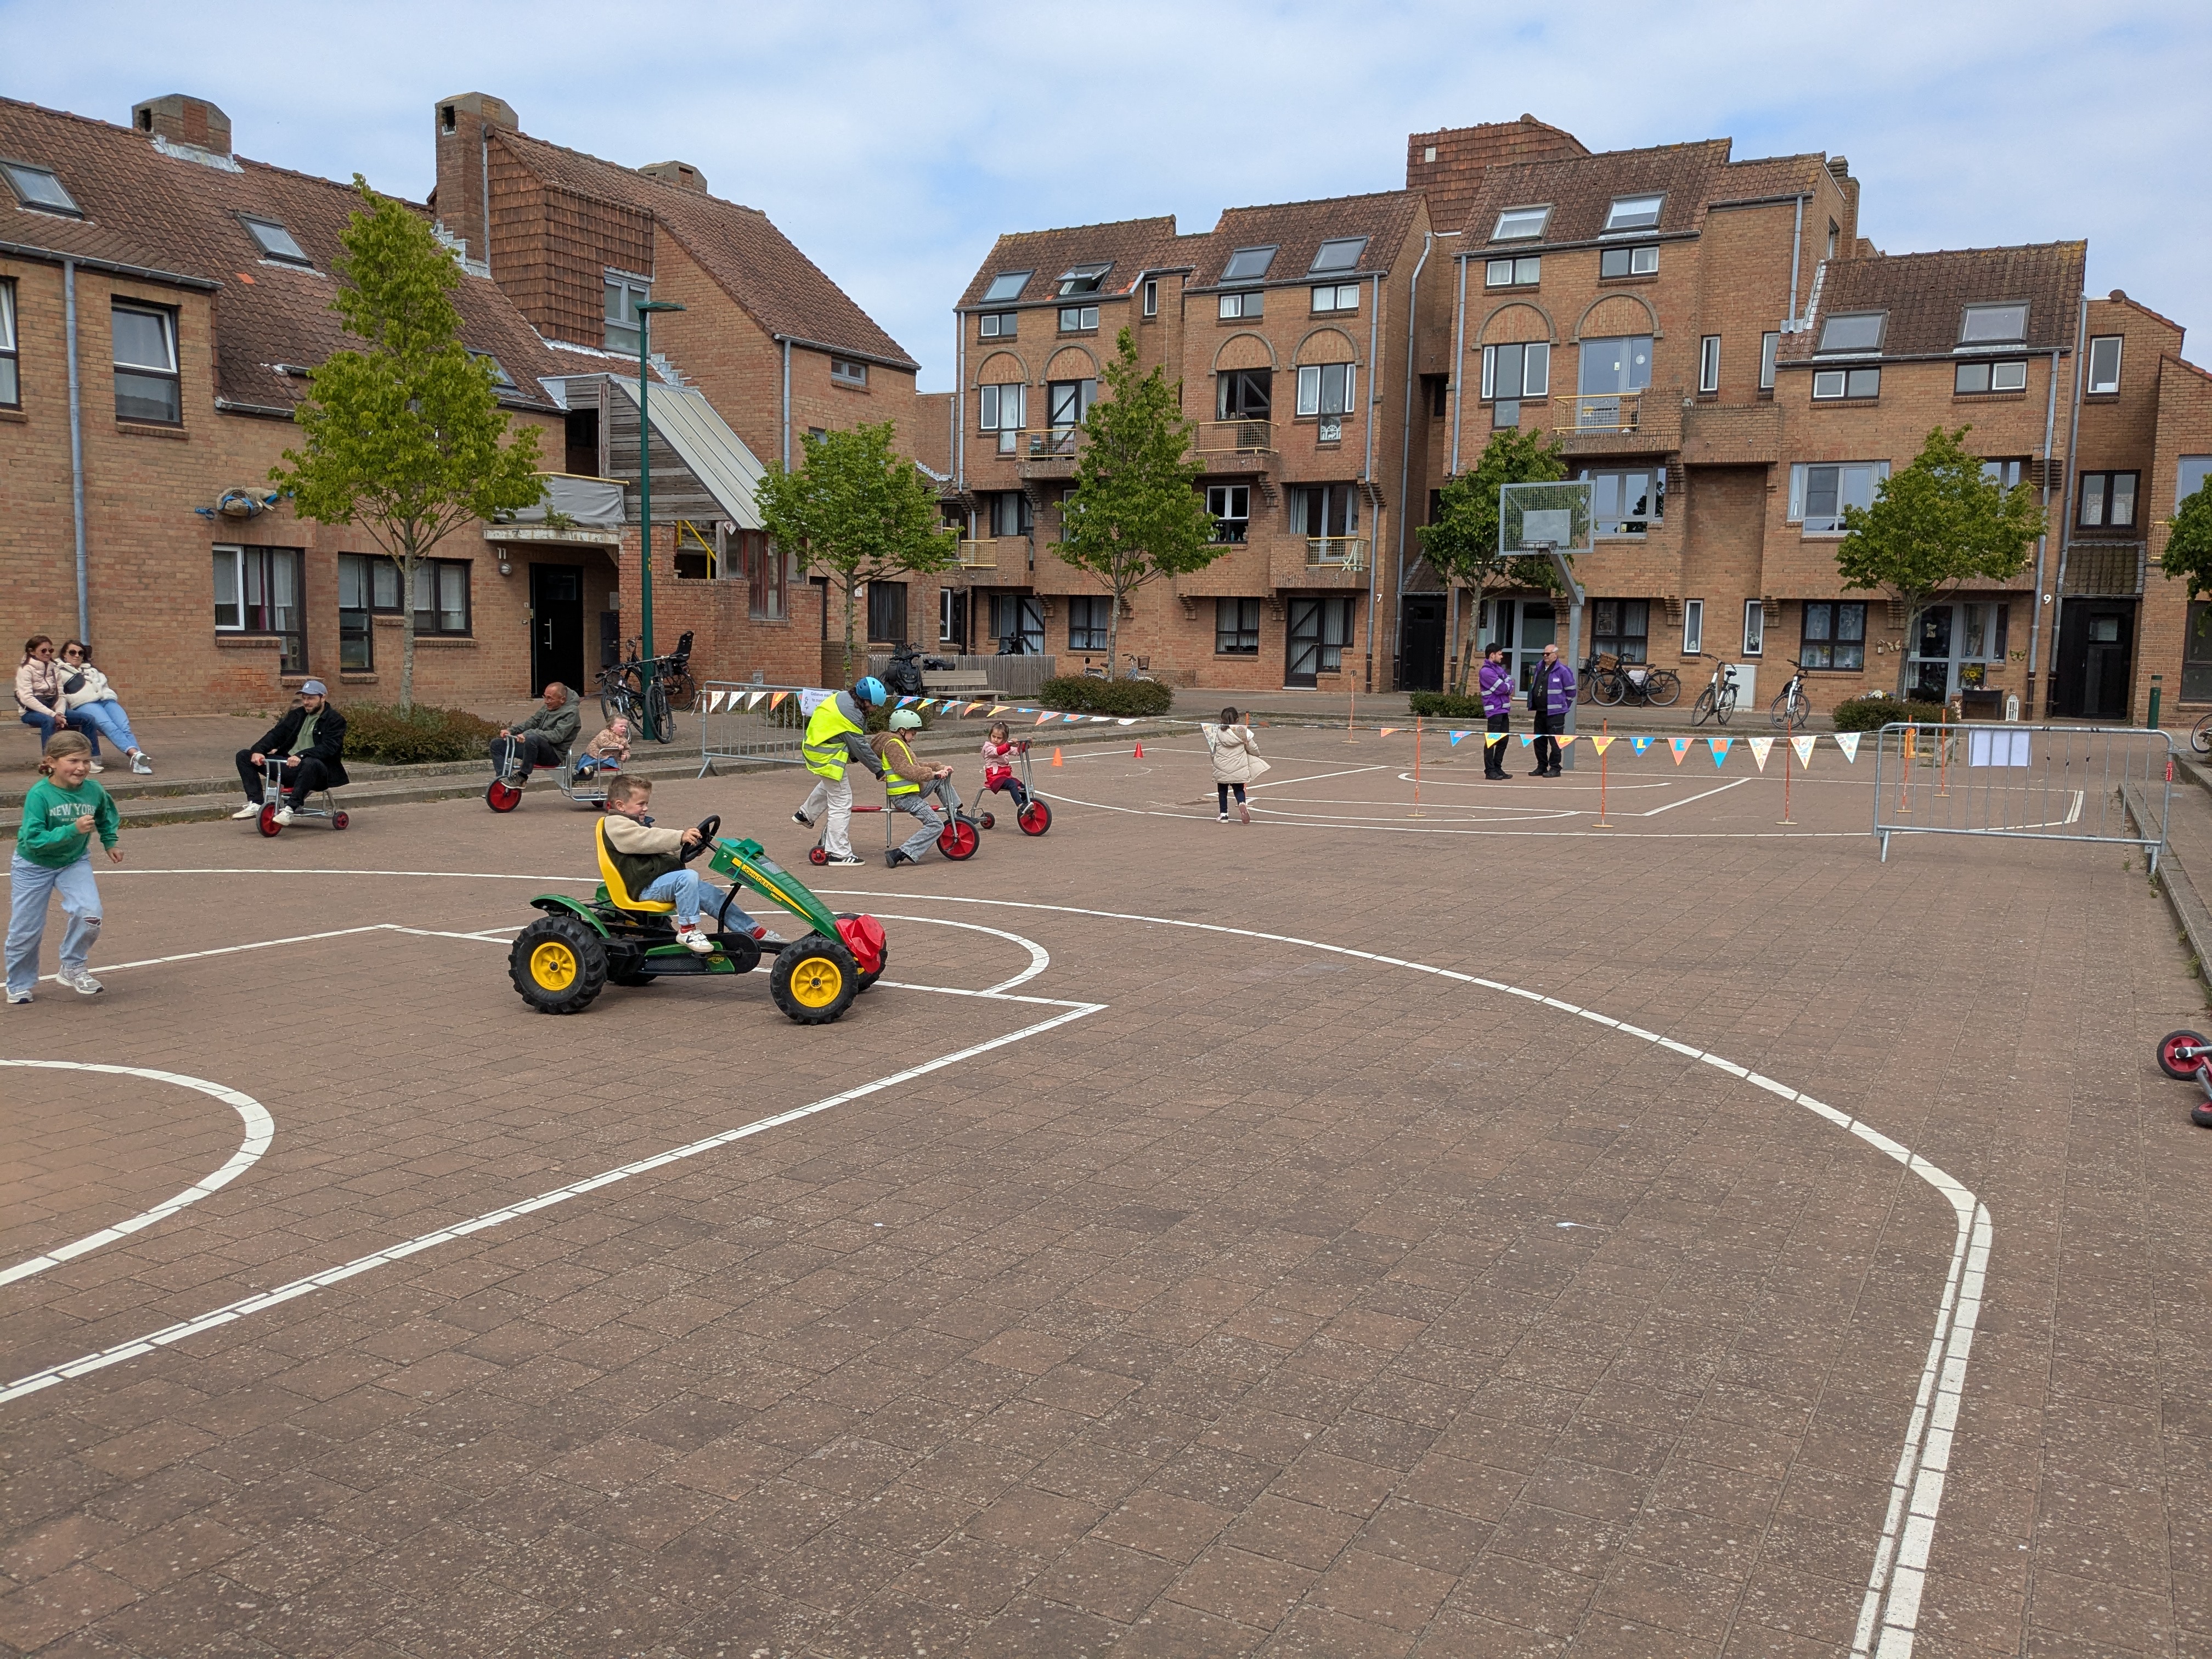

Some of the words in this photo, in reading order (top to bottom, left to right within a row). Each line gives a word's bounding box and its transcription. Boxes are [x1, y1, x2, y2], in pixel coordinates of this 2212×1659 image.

[497, 548, 506, 560] 11
[1376, 594, 1382, 602] 7
[2044, 594, 2051, 604] 9
[49, 803, 72, 816] NEW
[743, 867, 758, 879] JOHN
[757, 876, 775, 891] DEERE
